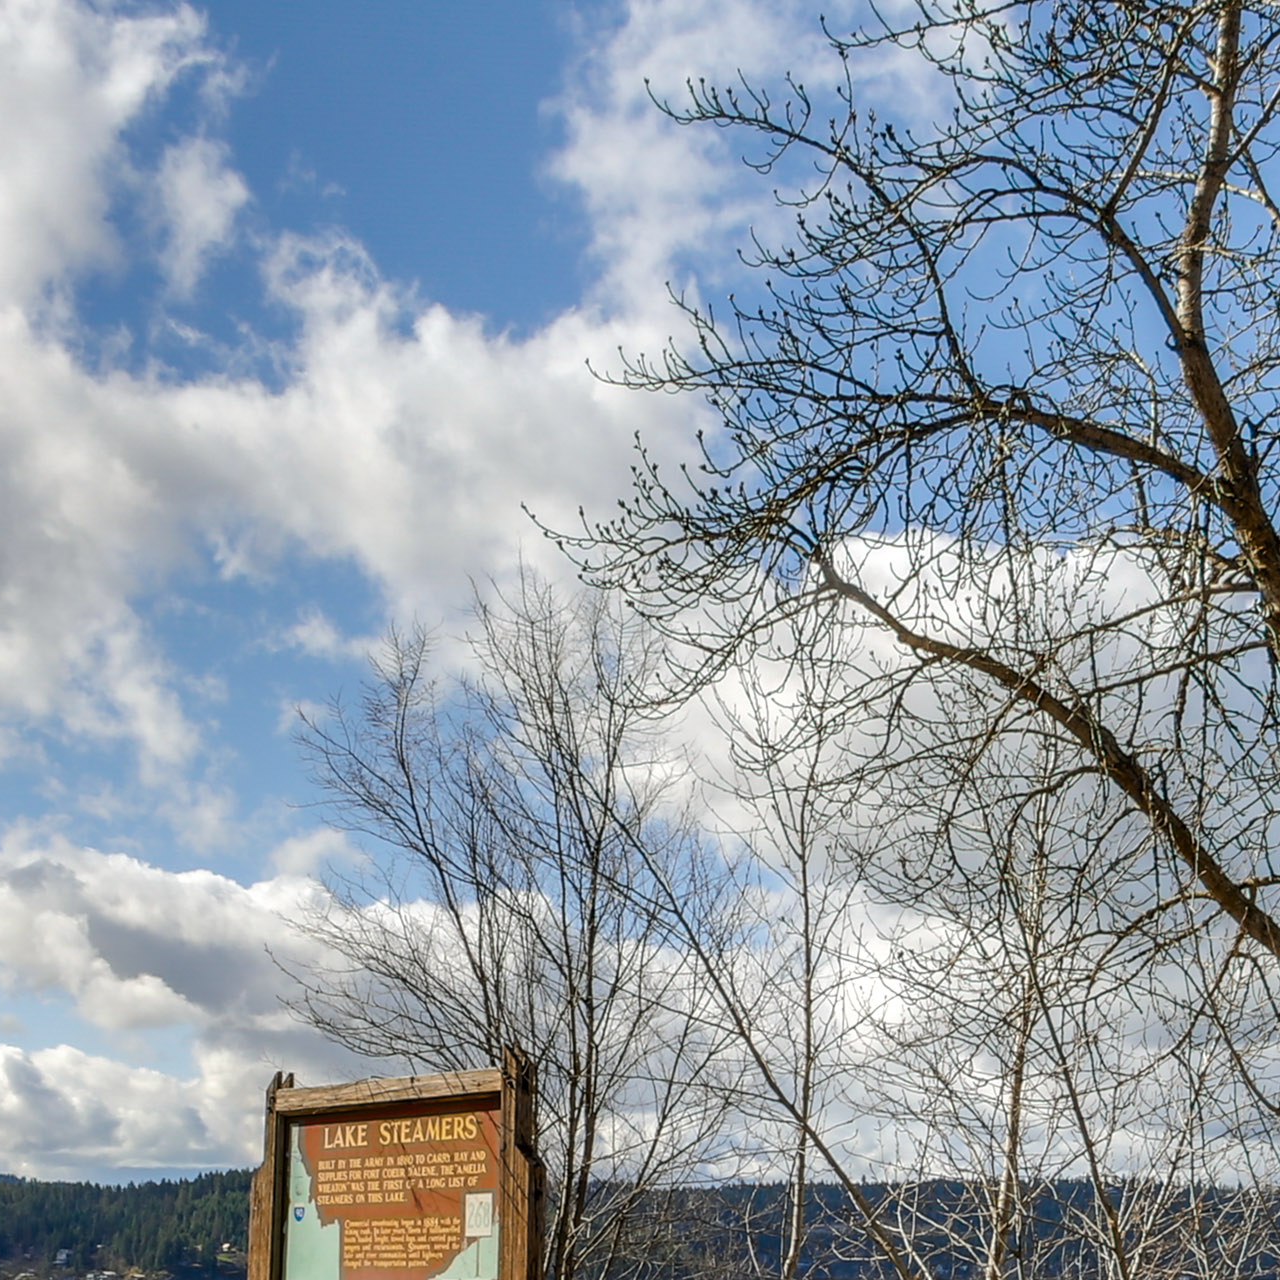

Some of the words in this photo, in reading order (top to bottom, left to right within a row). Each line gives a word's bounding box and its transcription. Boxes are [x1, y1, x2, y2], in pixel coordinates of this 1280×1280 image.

[324, 1125, 368, 1148] LAKE
[379, 1116, 477, 1144] STEAMERS
[350, 1159, 362, 1168] THE
[364, 1157, 384, 1167] ARMY
[387, 1157, 394, 1166] IN
[416, 1154, 425, 1164] TO
[470, 1150, 486, 1160] AND
[318, 1171, 348, 1182] SUPPLIES
[349, 1170, 362, 1180] FOR
[363, 1169, 380, 1179] FORT
[382, 1168, 406, 1178] COEUR
[441, 1165, 454, 1175] THE
[351, 1182, 365, 1192] WAS
[367, 1181, 380, 1191] THE
[383, 1180, 403, 1190] FIRST
[406, 1179, 416, 1189] OF
[418, 1179, 424, 1188] A
[425, 1178, 445, 1188] LONG
[448, 1176, 465, 1187] LIST
[468, 1176, 478, 1186] OF
[317, 1194, 353, 1205] STEAMERS
[355, 1194, 365, 1204] ON
[368, 1193, 383, 1203] THIS
